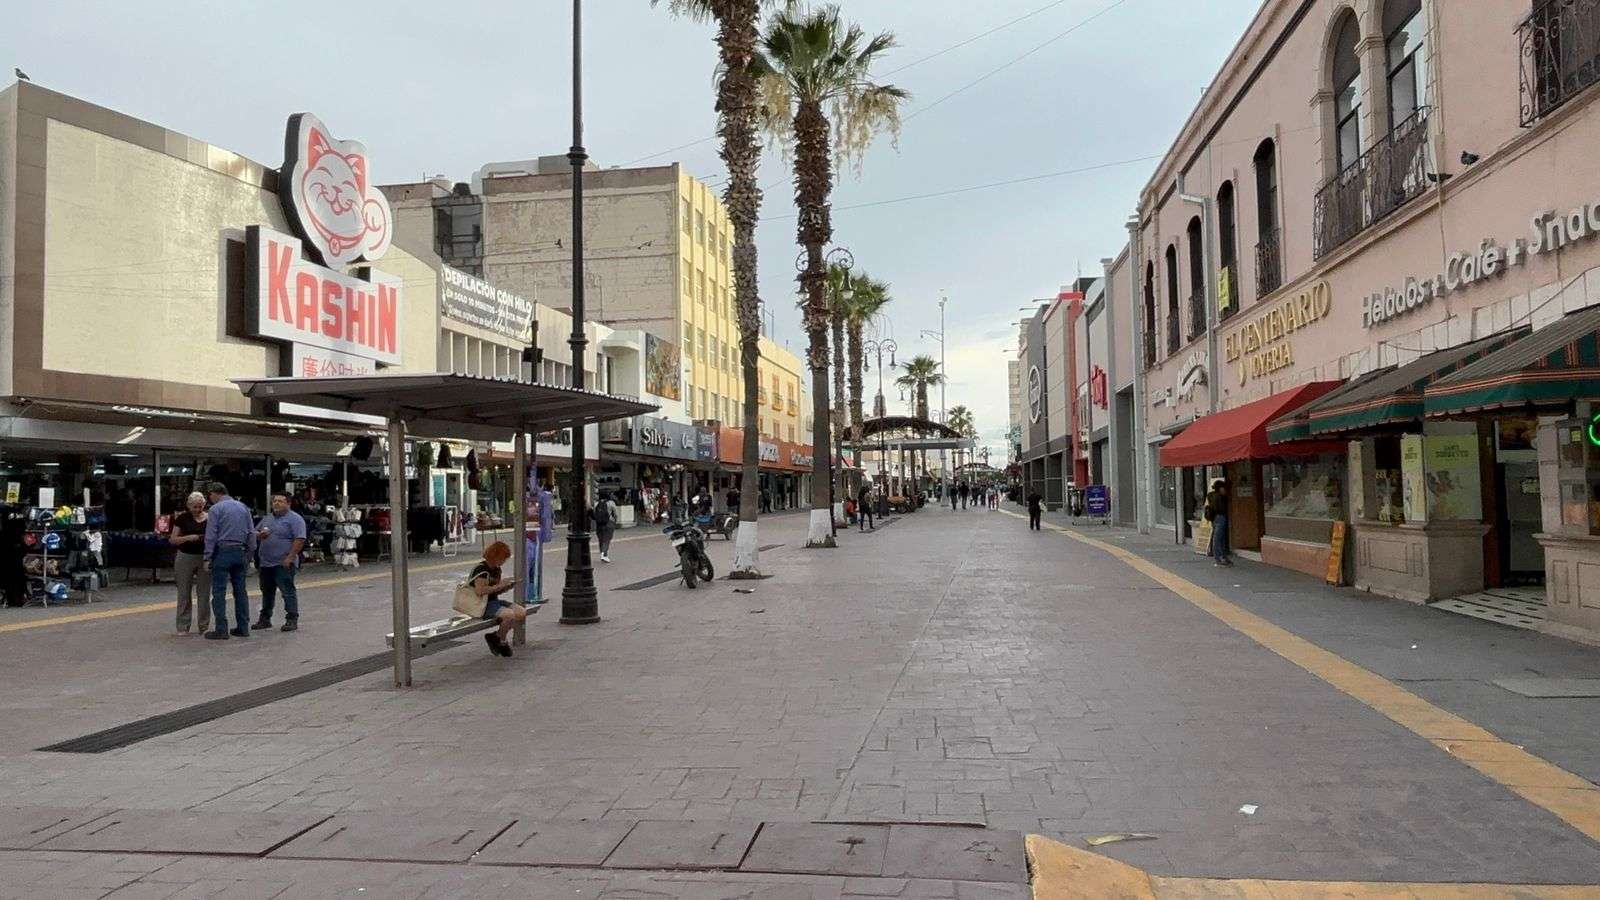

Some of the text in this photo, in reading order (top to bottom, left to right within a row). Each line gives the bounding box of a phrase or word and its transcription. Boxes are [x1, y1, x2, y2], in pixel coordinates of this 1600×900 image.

[268, 239, 396, 354] KASHIN
[445, 267, 496, 301] DEPILACIÓN
[497, 289, 514, 307] CON
[1362, 275, 1431, 329] Helados
[1445, 238, 1499, 290] Café
[1226, 333, 1241, 363] EL
[1240, 279, 1332, 355] CENTENARIO
[1239, 341, 1295, 387] JOYERIA
[642, 426, 672, 448] Silvia
